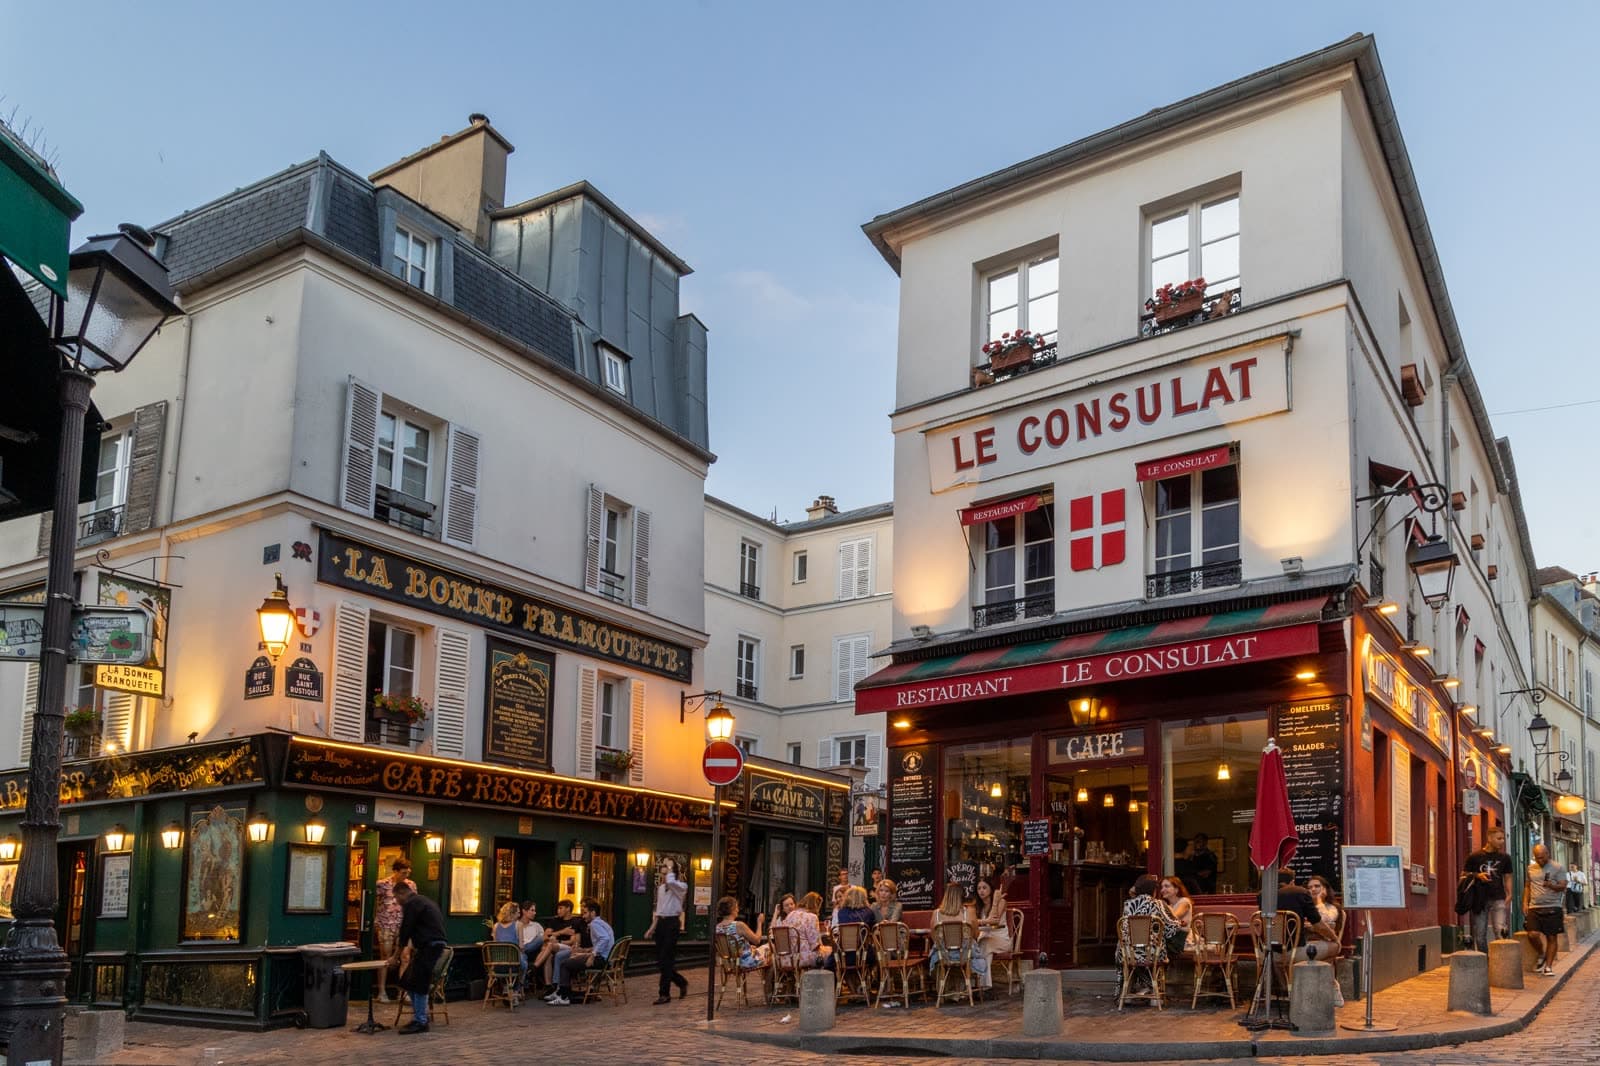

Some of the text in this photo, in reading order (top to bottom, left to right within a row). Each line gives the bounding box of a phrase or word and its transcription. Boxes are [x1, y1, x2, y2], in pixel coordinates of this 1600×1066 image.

[952, 357, 1258, 472] LE CONSULAT
[1147, 453, 1218, 477] LE CONSULAT
[973, 501, 1026, 521] RESTAURANT
[344, 548, 678, 672] LA BONNE FRANQUETTE
[107, 664, 153, 681] LA BONNE
[253, 671, 267, 681] RUE
[298, 672, 311, 681] RUE
[896, 636, 1258, 706] RESTAURANT LE CONSULAT
[101, 672, 159, 692] FRANQUETTE
[248, 684, 270, 694] SAULES
[290, 686, 318, 697] RUSTIQUE
[296, 680, 313, 688] SAINT
[1290, 703, 1330, 714] OMELETTES
[1292, 742, 1325, 752] SALADES
[178, 765, 206, 787] Boire
[383, 761, 684, 821] CAFÉ RESTAURANT VINS
[762, 788, 815, 808] LA CAVE DE
